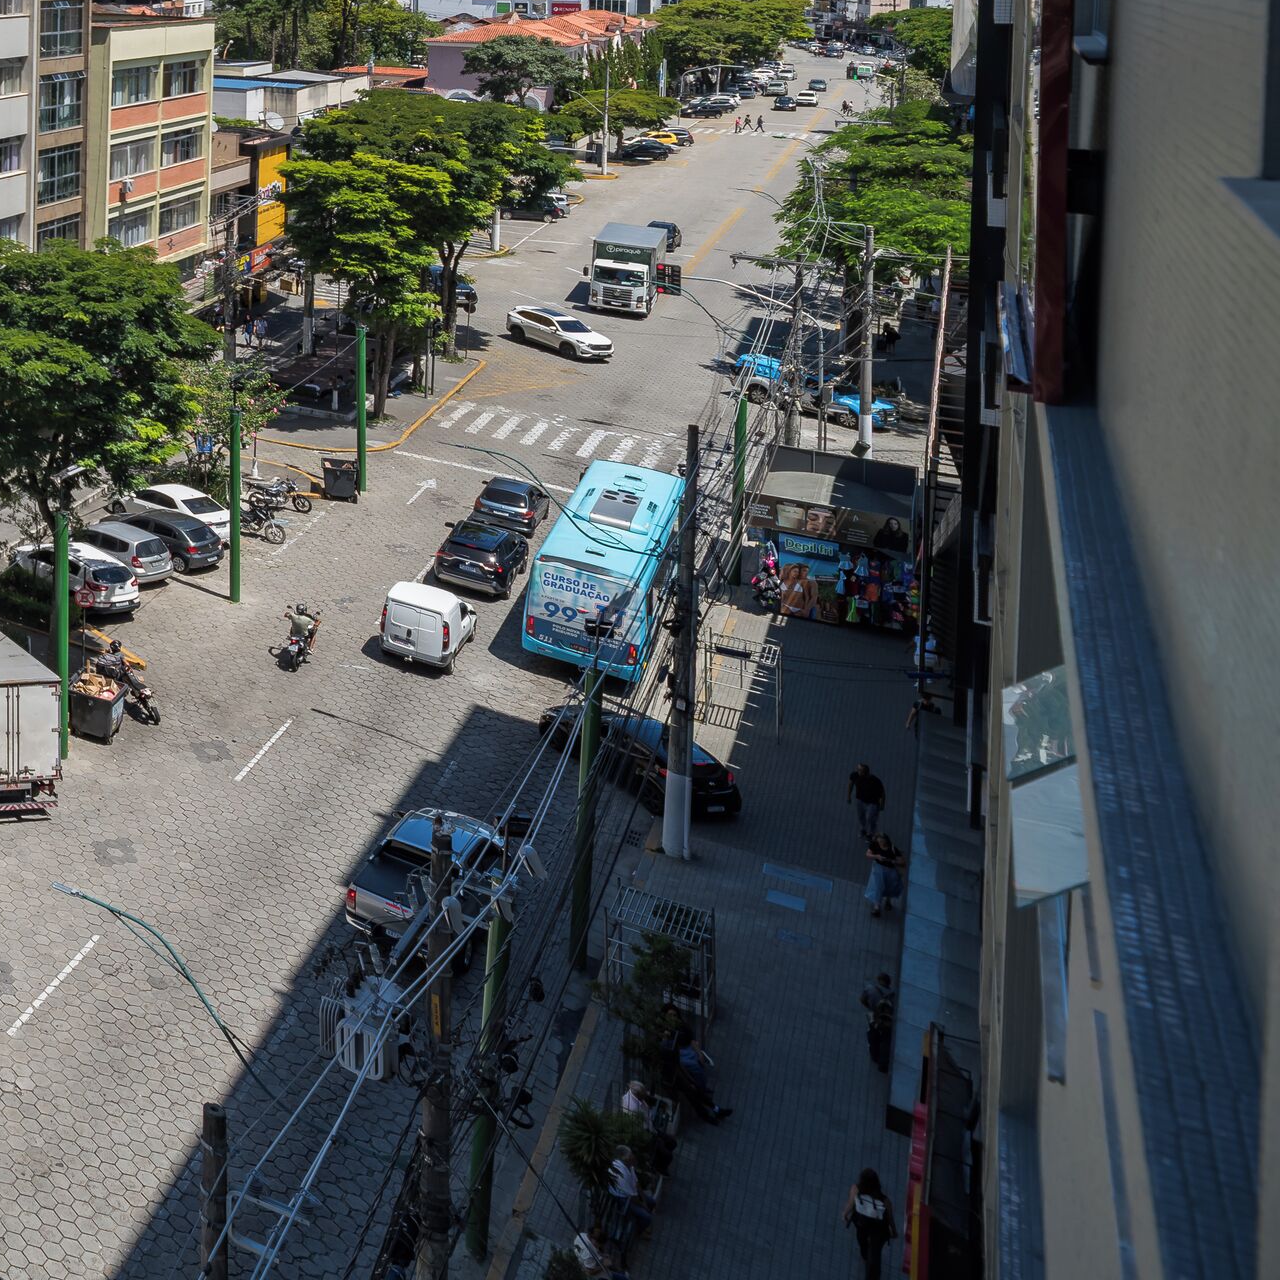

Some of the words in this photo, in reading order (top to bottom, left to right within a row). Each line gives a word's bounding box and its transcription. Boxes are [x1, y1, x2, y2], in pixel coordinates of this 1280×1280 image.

[784, 537, 817, 554] Depil
[543, 571, 580, 587] CURSO
[582, 582, 596, 592] DE
[543, 580, 610, 602] GRADUAÇÃO
